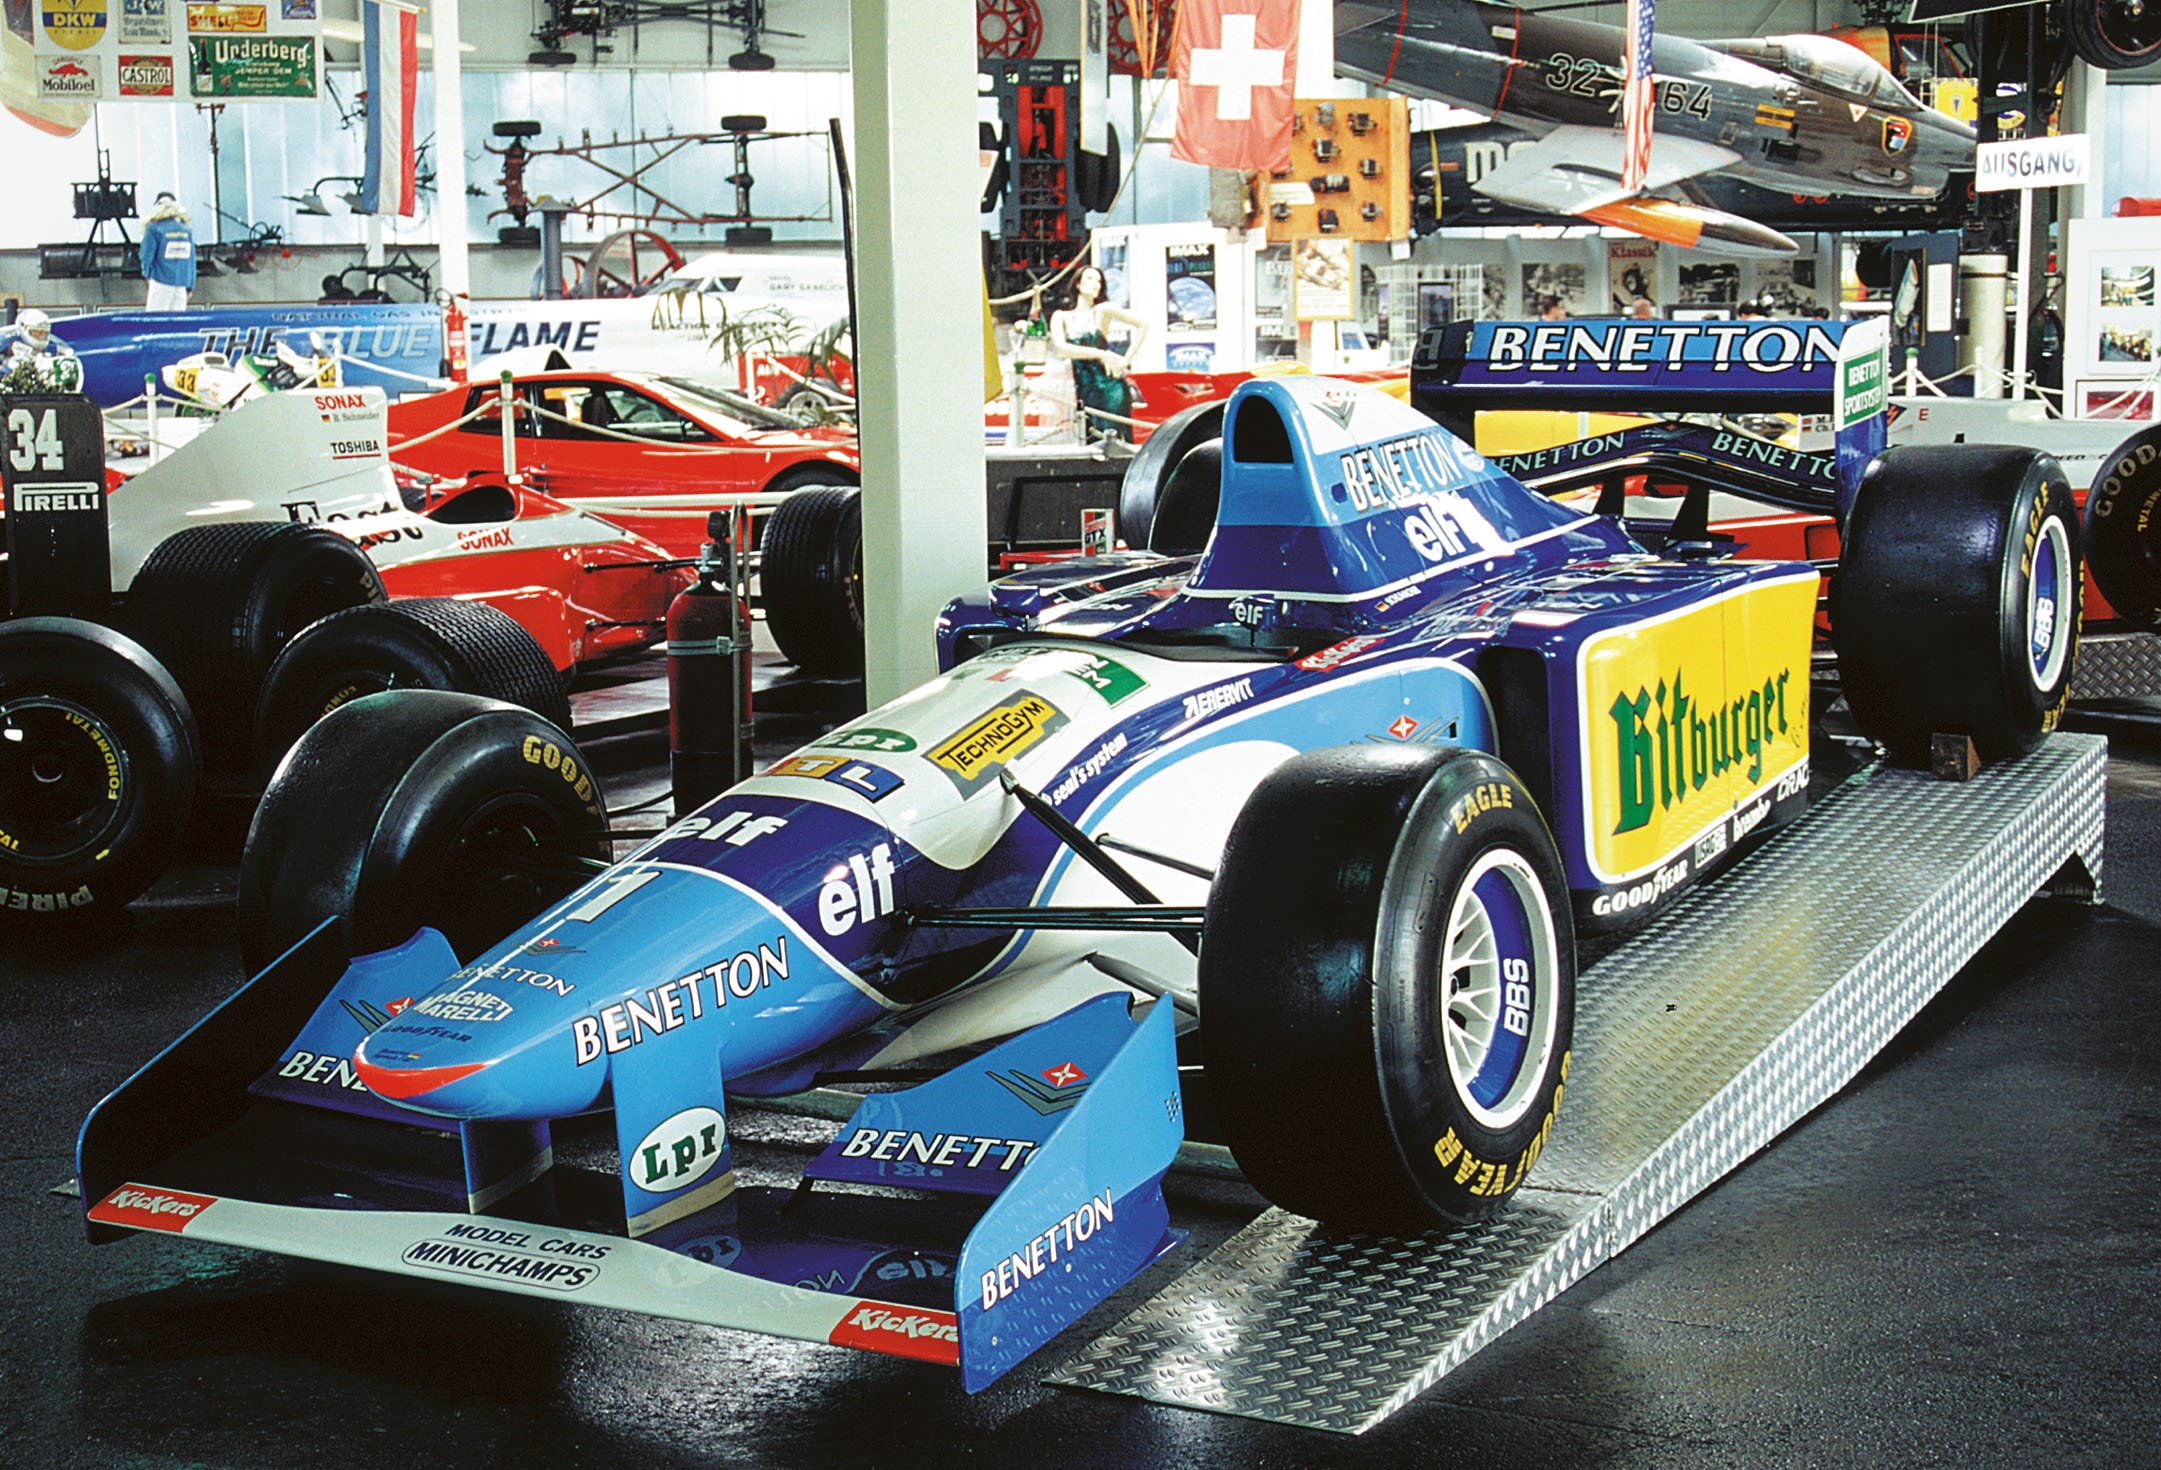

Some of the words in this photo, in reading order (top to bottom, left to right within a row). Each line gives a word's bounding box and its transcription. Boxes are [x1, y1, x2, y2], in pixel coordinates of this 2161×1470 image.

[53, 13, 96, 28] DKW
[43, 78, 95, 92] Mobiloel
[122, 68, 170, 84] CASTROL
[1546, 54, 1600, 97] 32
[1662, 81, 1713, 121] 64
[1982, 150, 2076, 177] AUSGANG
[1169, 244, 1209, 257] IMAX
[198, 326, 289, 358] THE
[471, 320, 600, 355] FLAME
[1488, 326, 1841, 372] BENETTON
[176, 369, 196, 396] 33
[314, 394, 367, 411] SONAX
[8, 408, 65, 472] 34
[330, 440, 380, 455] TOSHIBA
[1341, 431, 1463, 514] BENETTON
[2095, 444, 2161, 517] GOOD
[13, 482, 99, 512] PIRELLI
[457, 527, 514, 550] SONAX
[1404, 503, 1467, 562] elf
[1234, 603, 1263, 625] elf
[936, 699, 1046, 772] TECHNOGYM
[1086, 732, 1128, 776] system
[1608, 664, 1790, 836] Bitburger
[665, 811, 789, 847] elf
[1451, 783, 1514, 836] EAGLE
[819, 842, 896, 937] elf
[1592, 859, 1689, 916] GOODYEAR
[572, 936, 790, 1067] BENETTON
[1503, 956, 1531, 1038] BBS
[382, 1024, 473, 1042] GOODYEAR
[641, 1123, 717, 1185] Lpr
[841, 1128, 1042, 1172] BENETT
[107, 1189, 201, 1218] KicKers
[443, 1222, 530, 1248] MODEL
[541, 1237, 613, 1261] CARS
[980, 1187, 1115, 1311] BENETTON
[406, 1242, 597, 1287] MINICHAMPS
